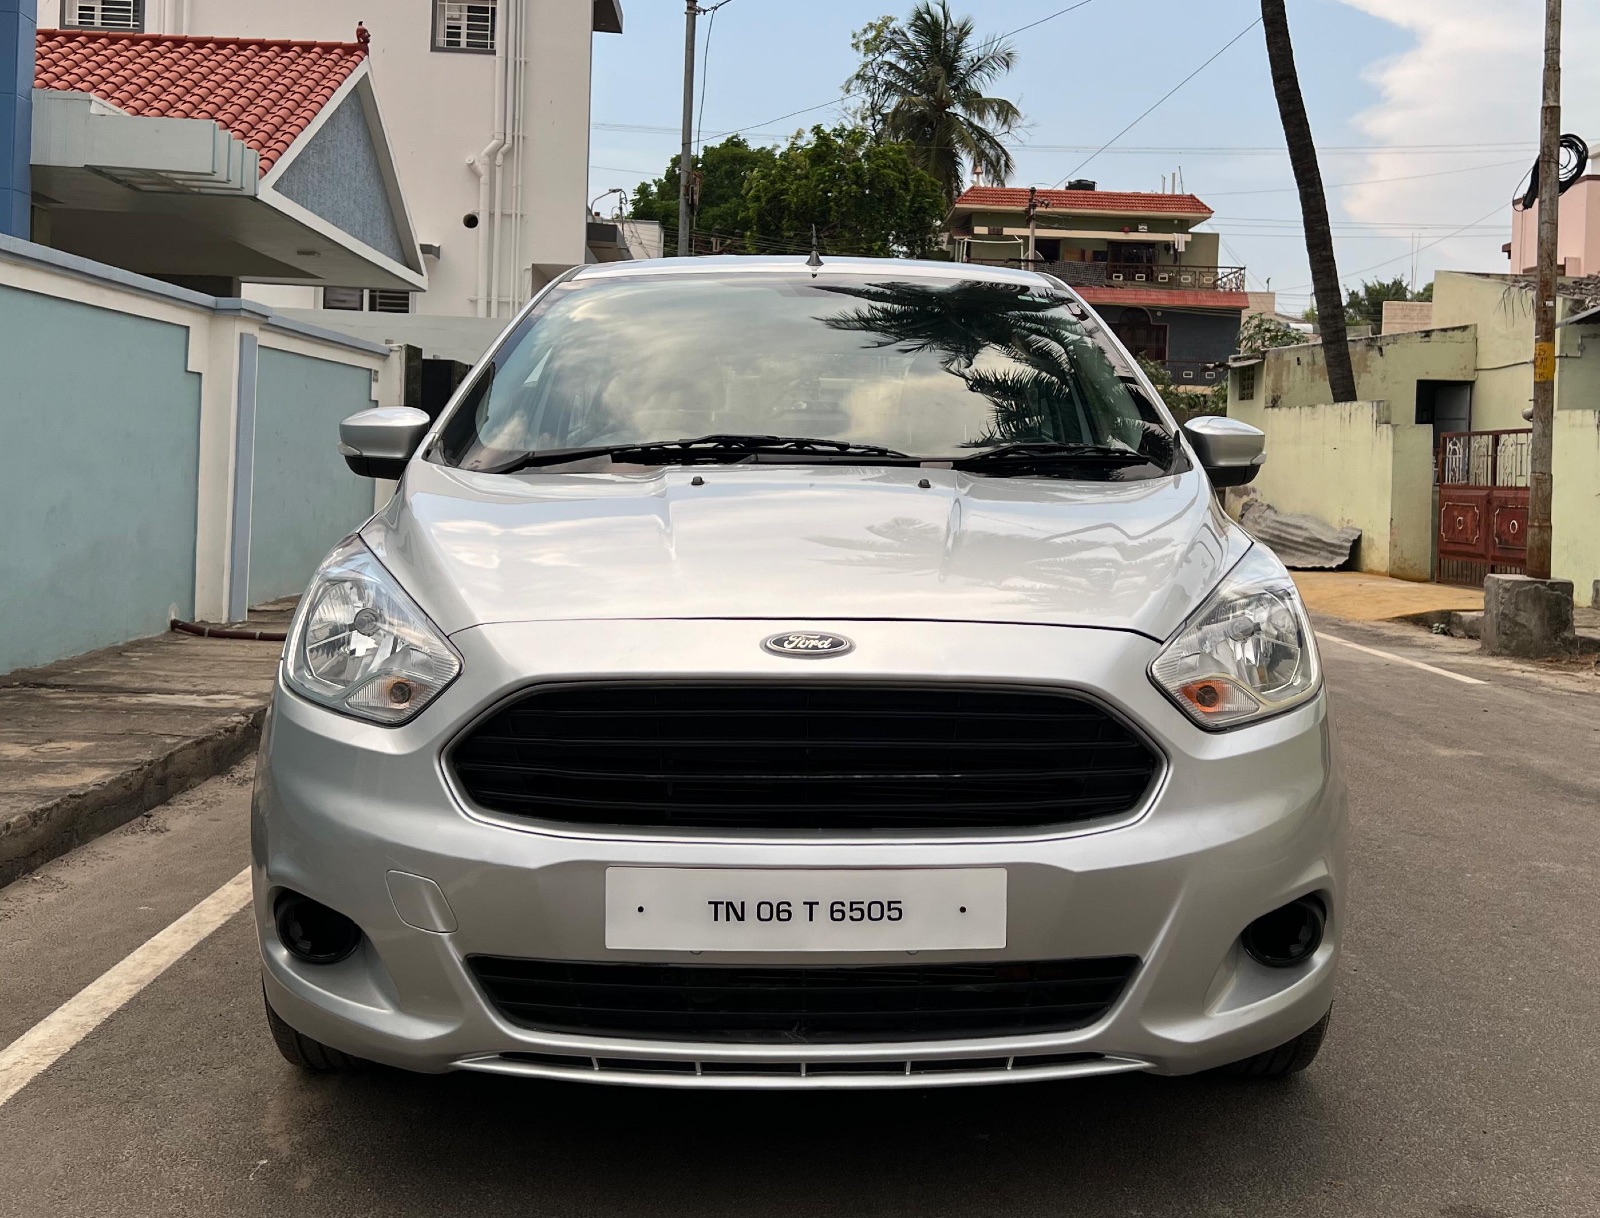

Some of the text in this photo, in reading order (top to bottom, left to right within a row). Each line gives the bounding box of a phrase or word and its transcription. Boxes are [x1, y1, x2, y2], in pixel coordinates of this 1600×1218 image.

[783, 634, 833, 649] Ford
[708, 900, 903, 922] TN 06 T 6505
